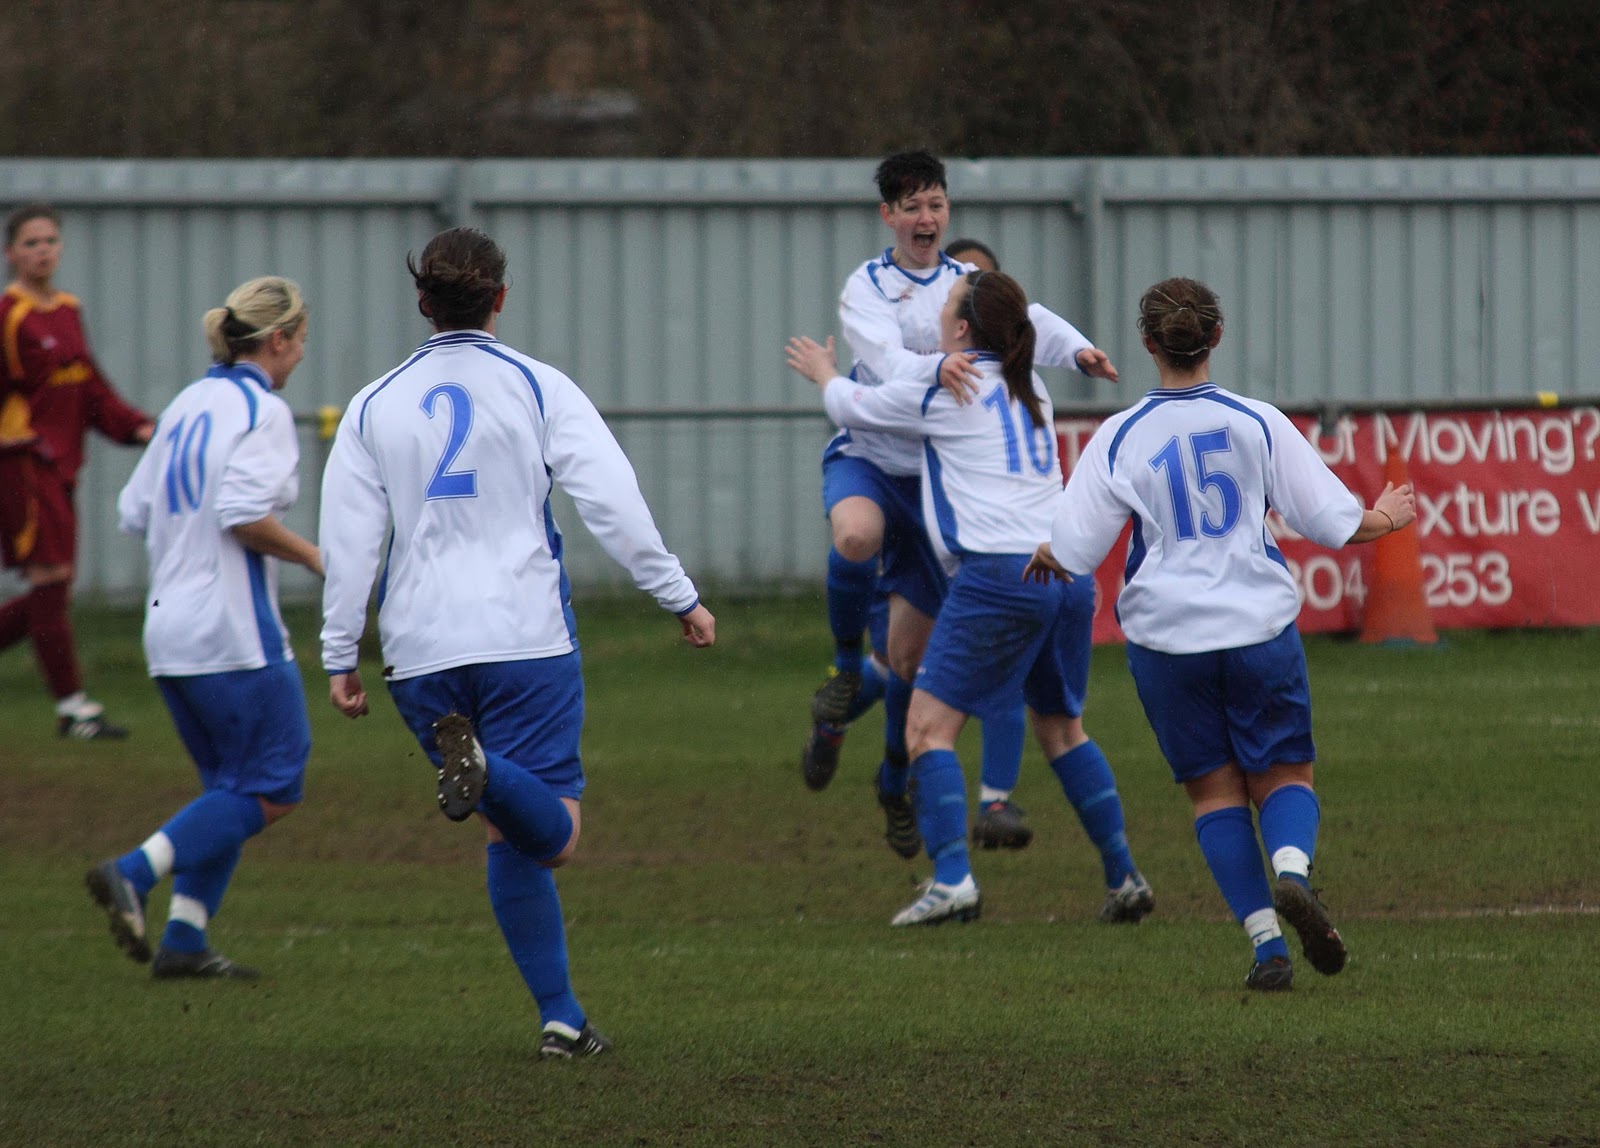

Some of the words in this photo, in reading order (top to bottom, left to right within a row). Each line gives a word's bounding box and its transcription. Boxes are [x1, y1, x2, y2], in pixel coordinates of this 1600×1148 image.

[166, 410, 213, 515] 10
[420, 382, 477, 500] 2
[1148, 427, 1242, 541] 15
[1374, 408, 1600, 475] Moving?
[1418, 481, 1561, 537] xture
